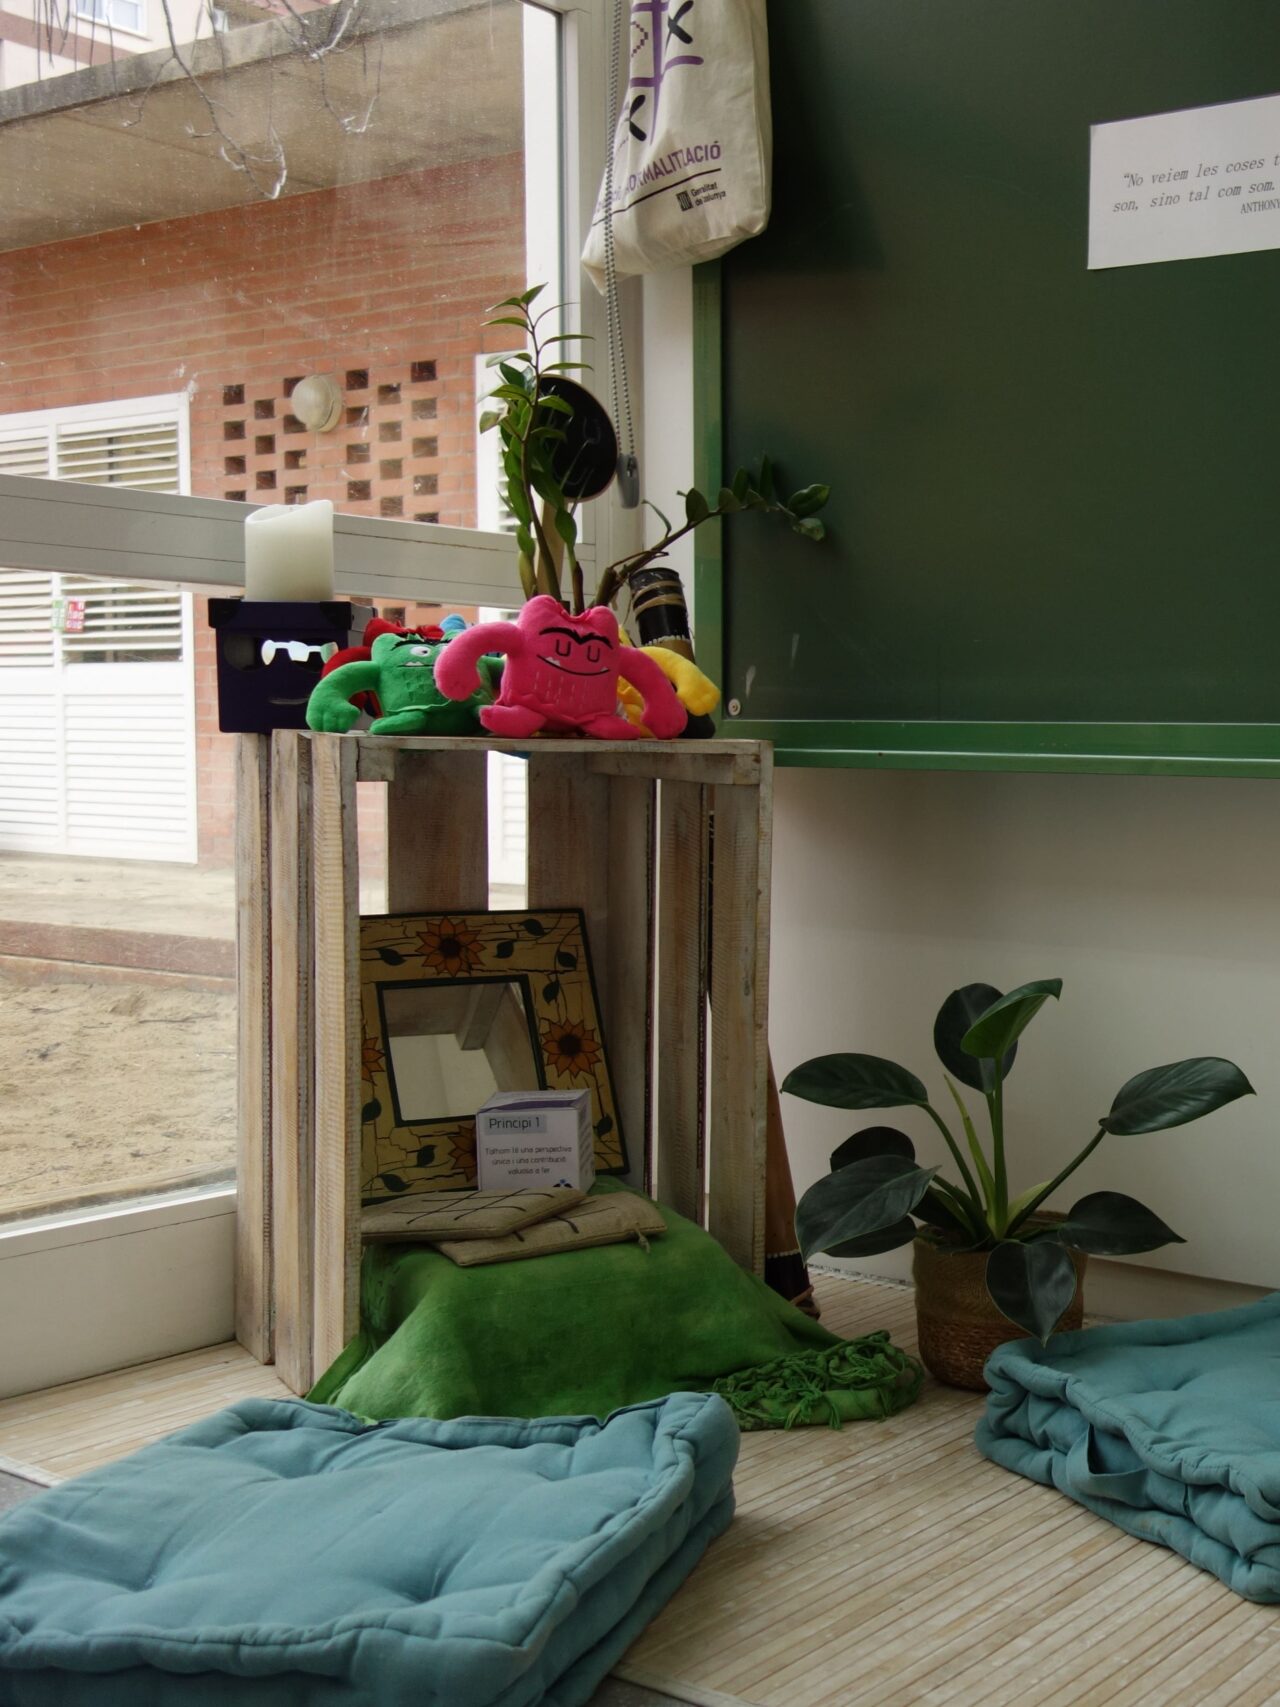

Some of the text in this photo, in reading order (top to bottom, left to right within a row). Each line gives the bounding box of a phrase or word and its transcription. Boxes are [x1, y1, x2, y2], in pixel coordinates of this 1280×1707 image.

[1151, 168, 1188, 184] veiem
[1195, 163, 1218, 178] les
[1225, 157, 1265, 173] coses
[1113, 200, 1139, 213] son,
[1150, 194, 1180, 208] sino
[1188, 186, 1210, 202] tal
[1217, 185, 1242, 199] com
[489, 1116, 541, 1131] Principi 1
